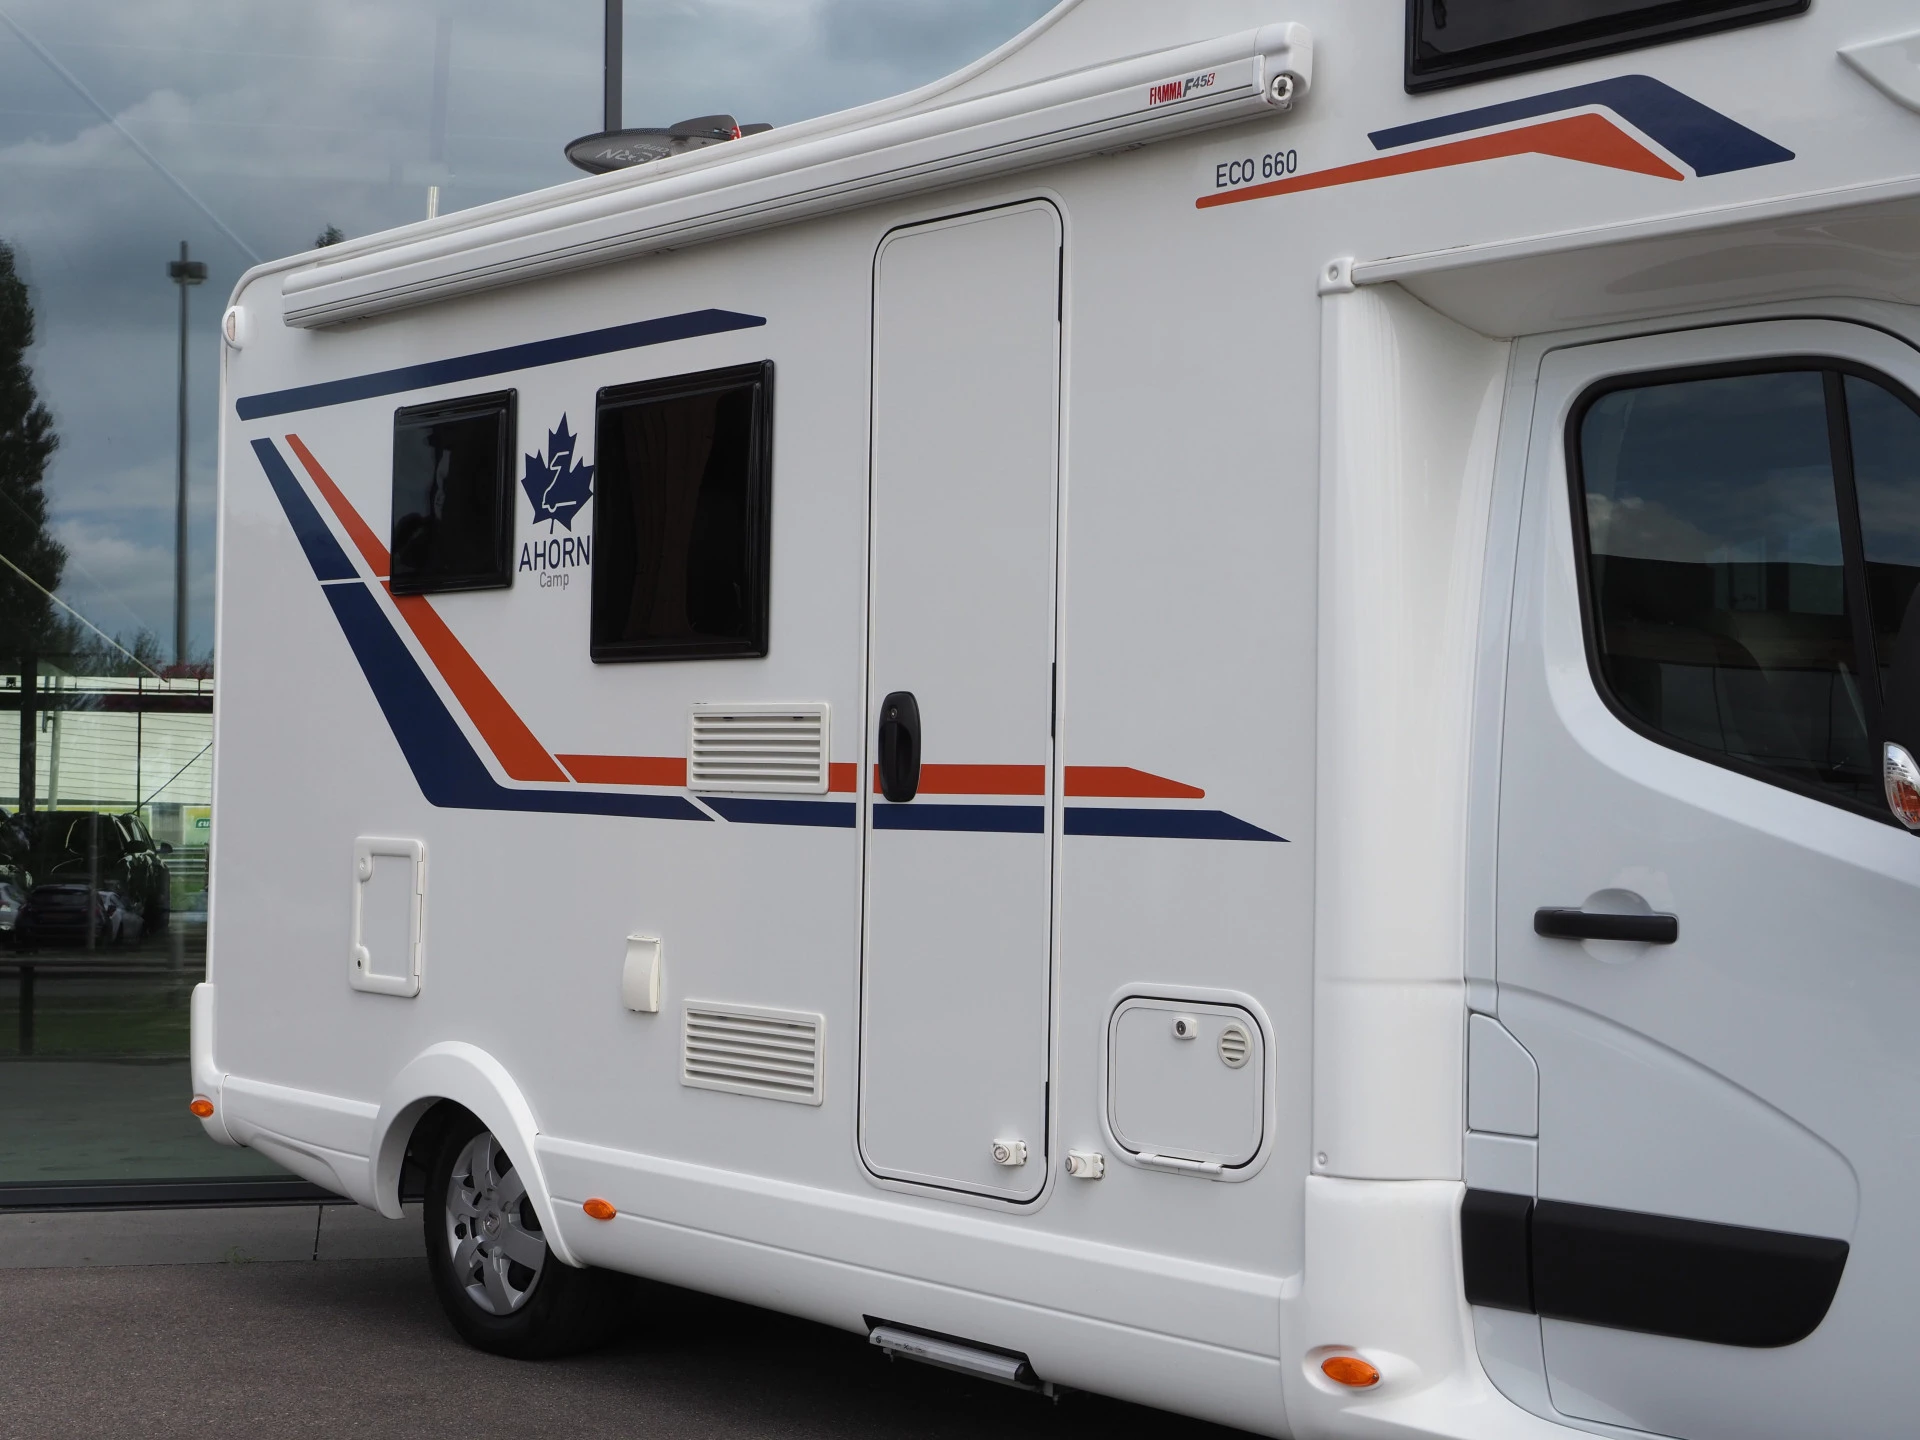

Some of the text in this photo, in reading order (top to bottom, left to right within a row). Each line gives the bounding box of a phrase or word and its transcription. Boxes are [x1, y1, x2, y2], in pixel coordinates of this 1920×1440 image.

[1149, 81, 1182, 105] FIAMMA
[1216, 149, 1297, 188] ECO 660
[519, 535, 590, 572] AHORN
[539, 572, 569, 590] Camp
